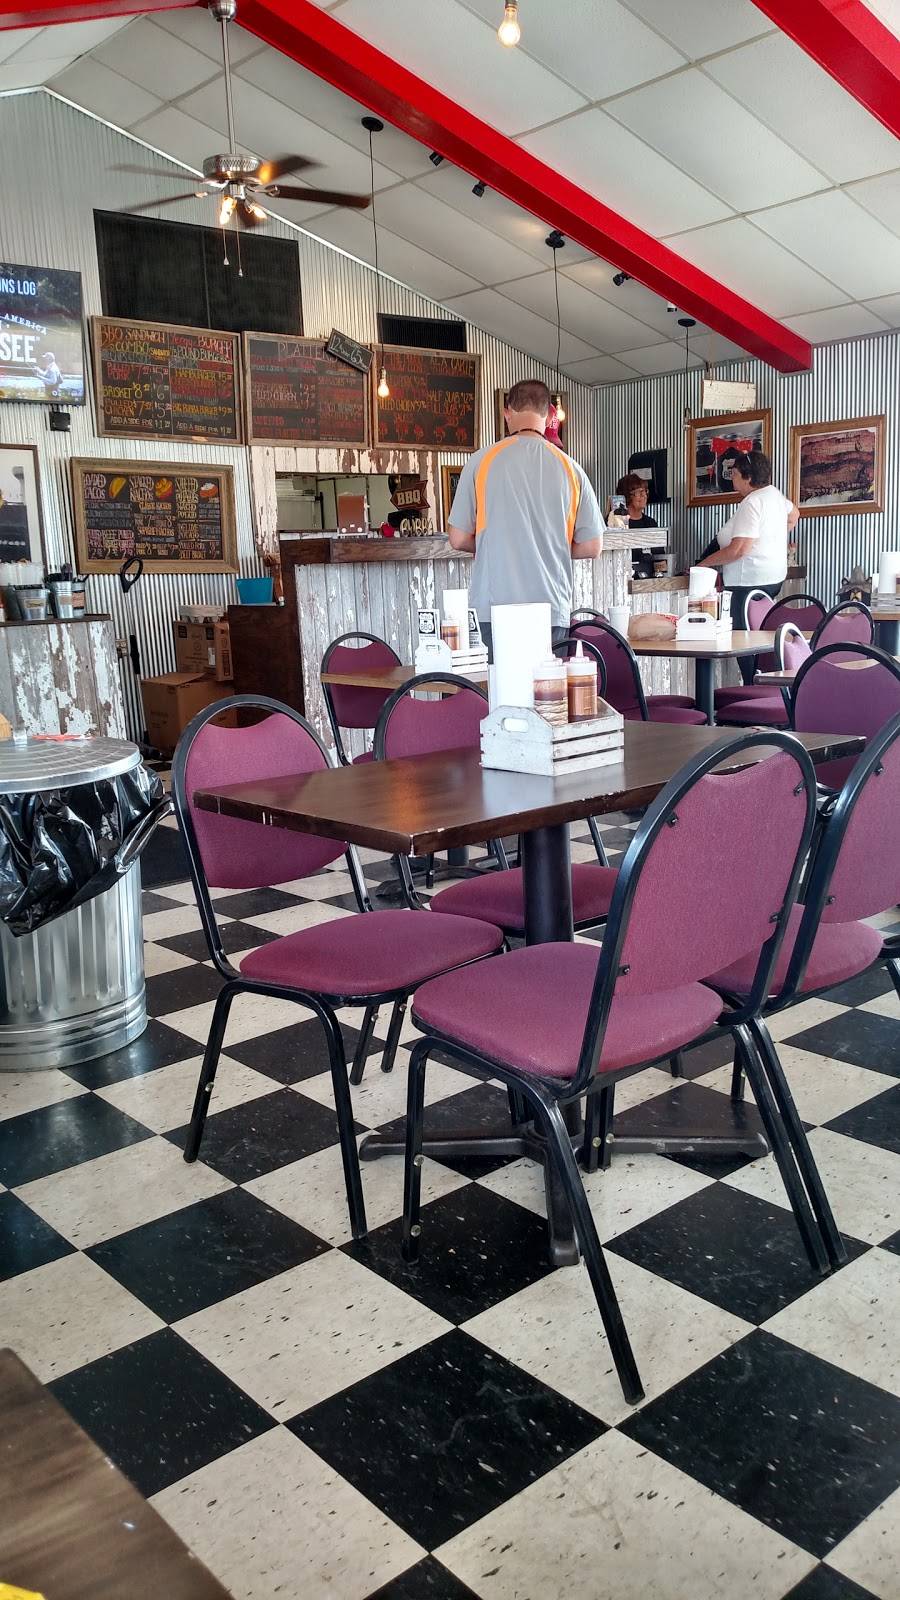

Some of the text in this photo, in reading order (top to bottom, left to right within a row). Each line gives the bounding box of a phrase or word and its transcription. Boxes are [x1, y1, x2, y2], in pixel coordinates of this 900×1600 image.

[0, 277, 36, 296] NS LOG
[4, 313, 47, 336] AMERICA
[126, 328, 165, 344] SANDWICH
[103, 385, 132, 399] BRISKET
[84, 487, 106, 500] TACOS
[396, 489, 421, 506] BBQ
